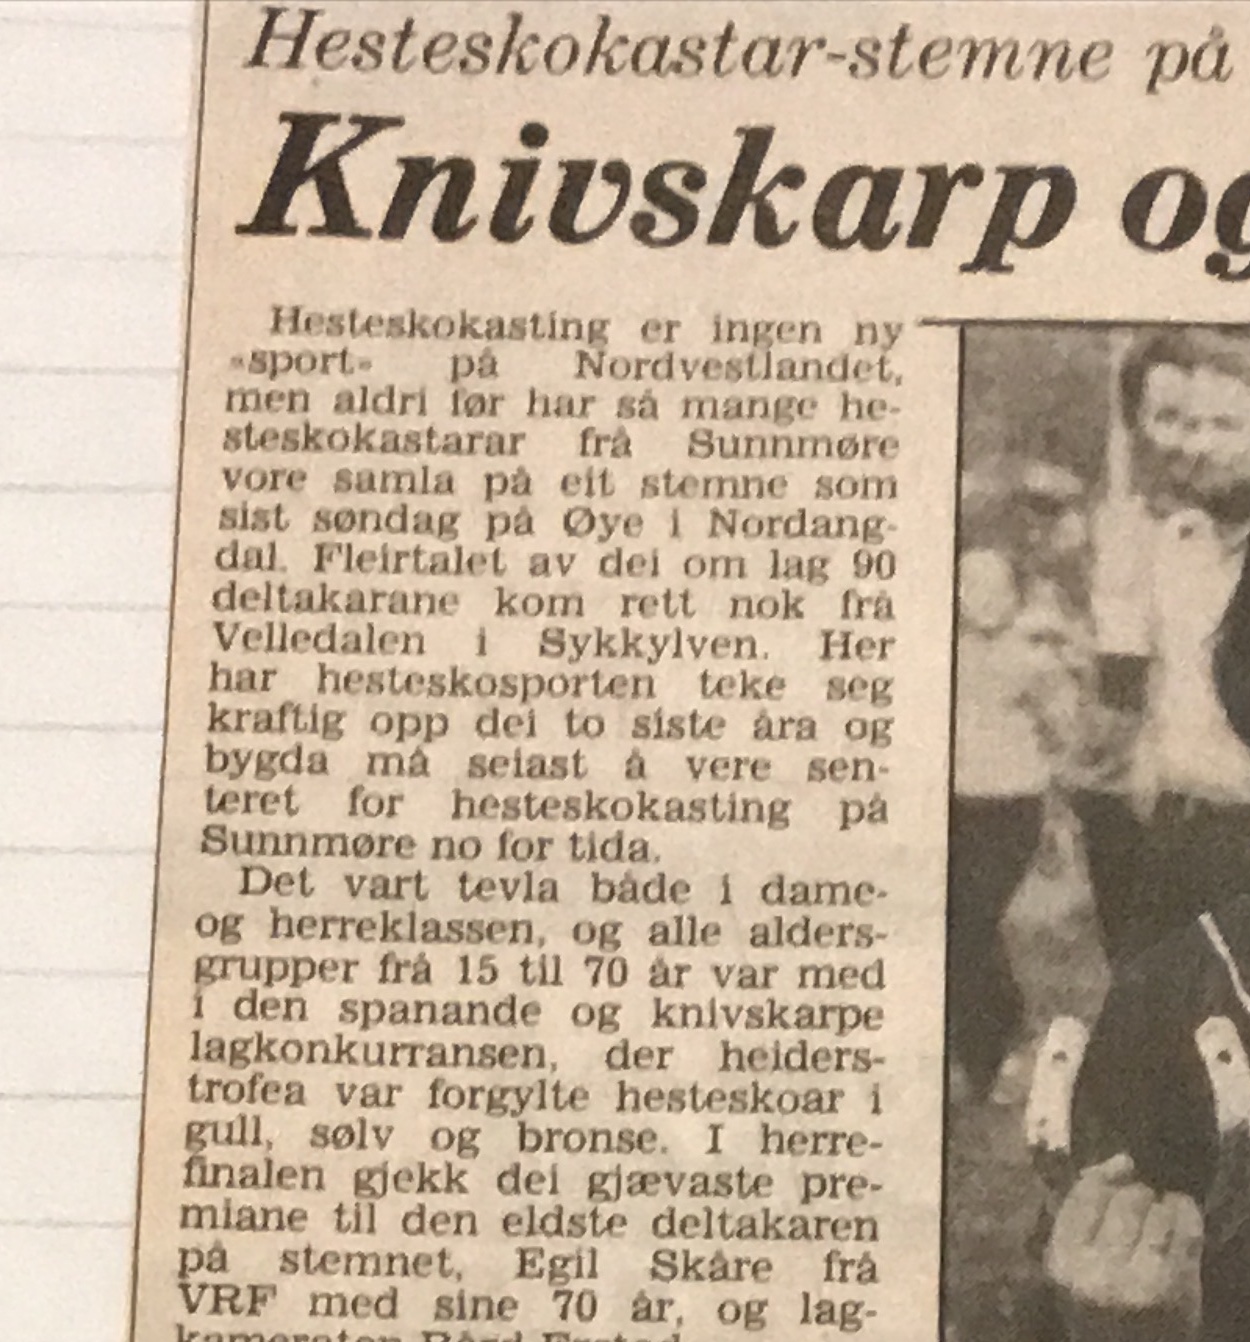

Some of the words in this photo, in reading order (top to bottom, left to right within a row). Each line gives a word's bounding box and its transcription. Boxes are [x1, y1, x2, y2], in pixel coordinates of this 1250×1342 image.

[243, 4, 1115, 84] Hesteskokastar-stemne
[1146, 24, 1234, 96] på
[234, 111, 1077, 274] Knivskarp
[270, 305, 610, 346] Hesteskokasting
[641, 319, 681, 341] er
[713, 314, 821, 351] ingen
[854, 322, 903, 353] ny
[450, 339, 501, 385] på
[575, 345, 902, 384] Nordvestlandet,
[223, 420, 526, 452] steskokastarar
[579, 426, 632, 456] frå
[688, 429, 899, 459] Sunnmøre
[219, 501, 289, 530] sist
[313, 503, 461, 541] søndag
[485, 496, 534, 542] på
[563, 506, 643, 543] Øye
[670, 508, 680, 536] i
[708, 508, 896, 545] Nordang-
[213, 621, 425, 653] Velledalen
[477, 627, 487, 655] i
[539, 627, 768, 665] Sykkylven.
[819, 629, 896, 661] Her
[205, 785, 299, 815] teret
[348, 784, 404, 816] for
[451, 788, 791, 829] hesteskokasting
[839, 792, 888, 831] på
[200, 824, 416, 856] Sunnmøre
[431, 836, 482, 859] no
[497, 829, 554, 860] for
[569, 830, 660, 861] tida.
[194, 955, 360, 990] grupper
[378, 951, 432, 983] frå
[459, 954, 498, 984] 15
[519, 954, 563, 985] til
[584, 955, 628, 986] 70
[649, 957, 691, 987] år
[711, 965, 779, 988] var
[798, 958, 886, 989] med
[188, 1072, 305, 1104] trofea
[336, 1083, 403, 1106] var
[428, 1077, 589, 1117] forgylte
[616, 1080, 845, 1112] hesteskoar
[870, 1083, 882, 1114] i
[177, 1240, 229, 1283] på
[279, 1244, 462, 1280] stemnet,
[515, 1247, 598, 1287] Egil
[649, 1249, 773, 1281] Skåre
[824, 1249, 879, 1284] frå
